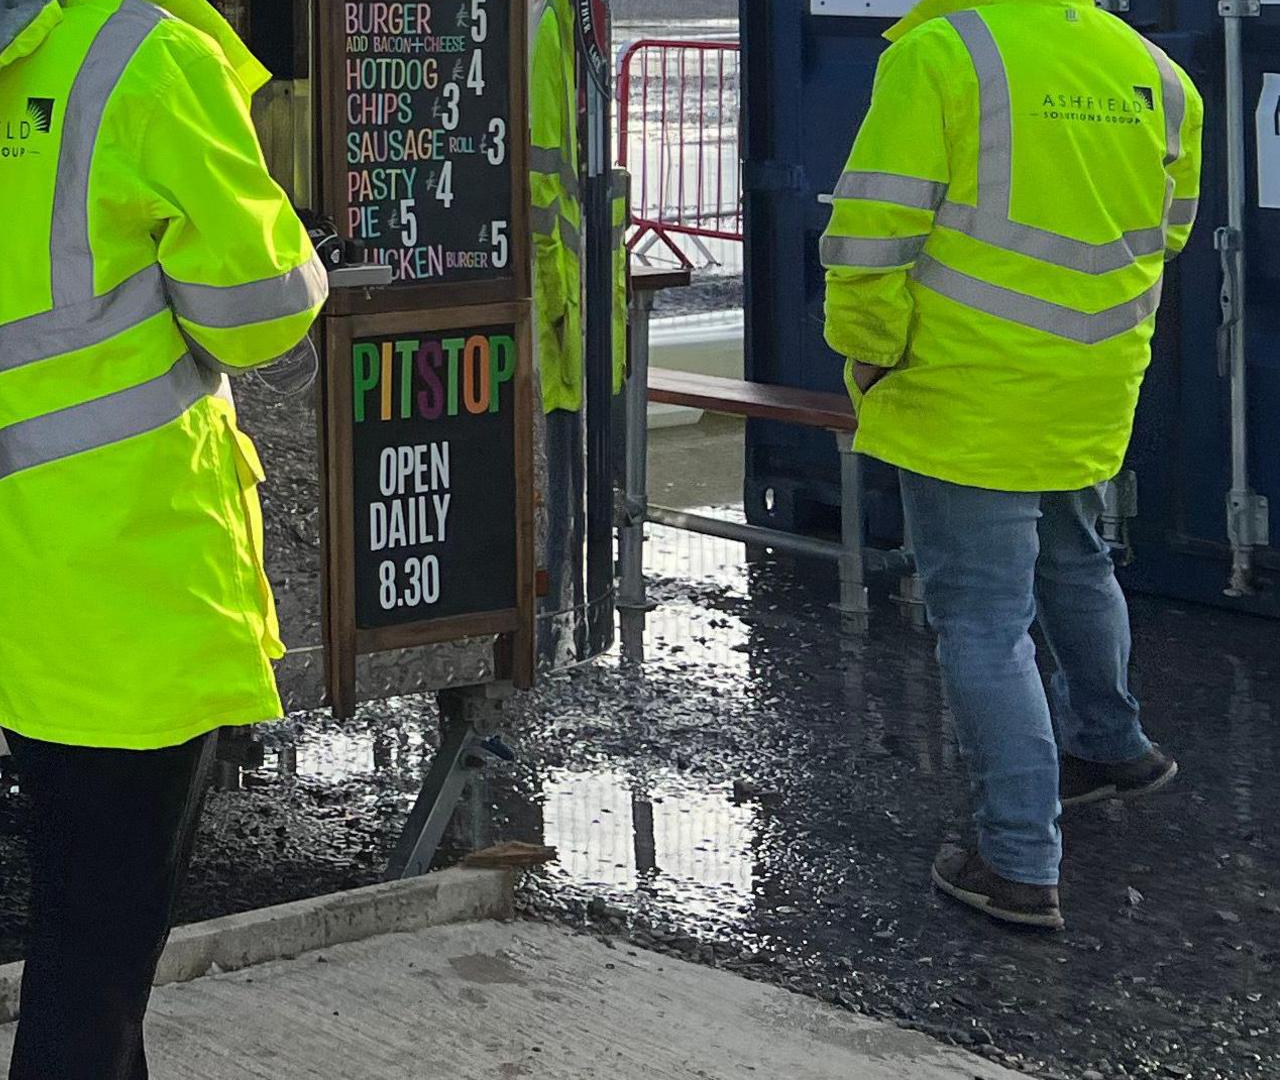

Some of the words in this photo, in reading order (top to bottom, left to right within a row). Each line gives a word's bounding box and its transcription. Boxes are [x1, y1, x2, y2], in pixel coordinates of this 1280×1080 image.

[344, 2, 431, 35] BURGER
[346, 36, 368, 53] ADD
[346, 58, 438, 90] HOTDOG
[347, 93, 412, 125] CHIPS
[1043, 94, 1141, 114] ASHFIELD
[347, 128, 445, 163] SAUSAGE
[449, 136, 475, 154] ROLL
[348, 168, 417, 203] PASTY
[348, 205, 380, 240] PIE
[363, 244, 444, 281] ICKEN
[446, 251, 488, 269] BURGER
[379, 441, 450, 496] OPEN
[370, 494, 451, 551] DAILY
[379, 555, 440, 610] 8.30
